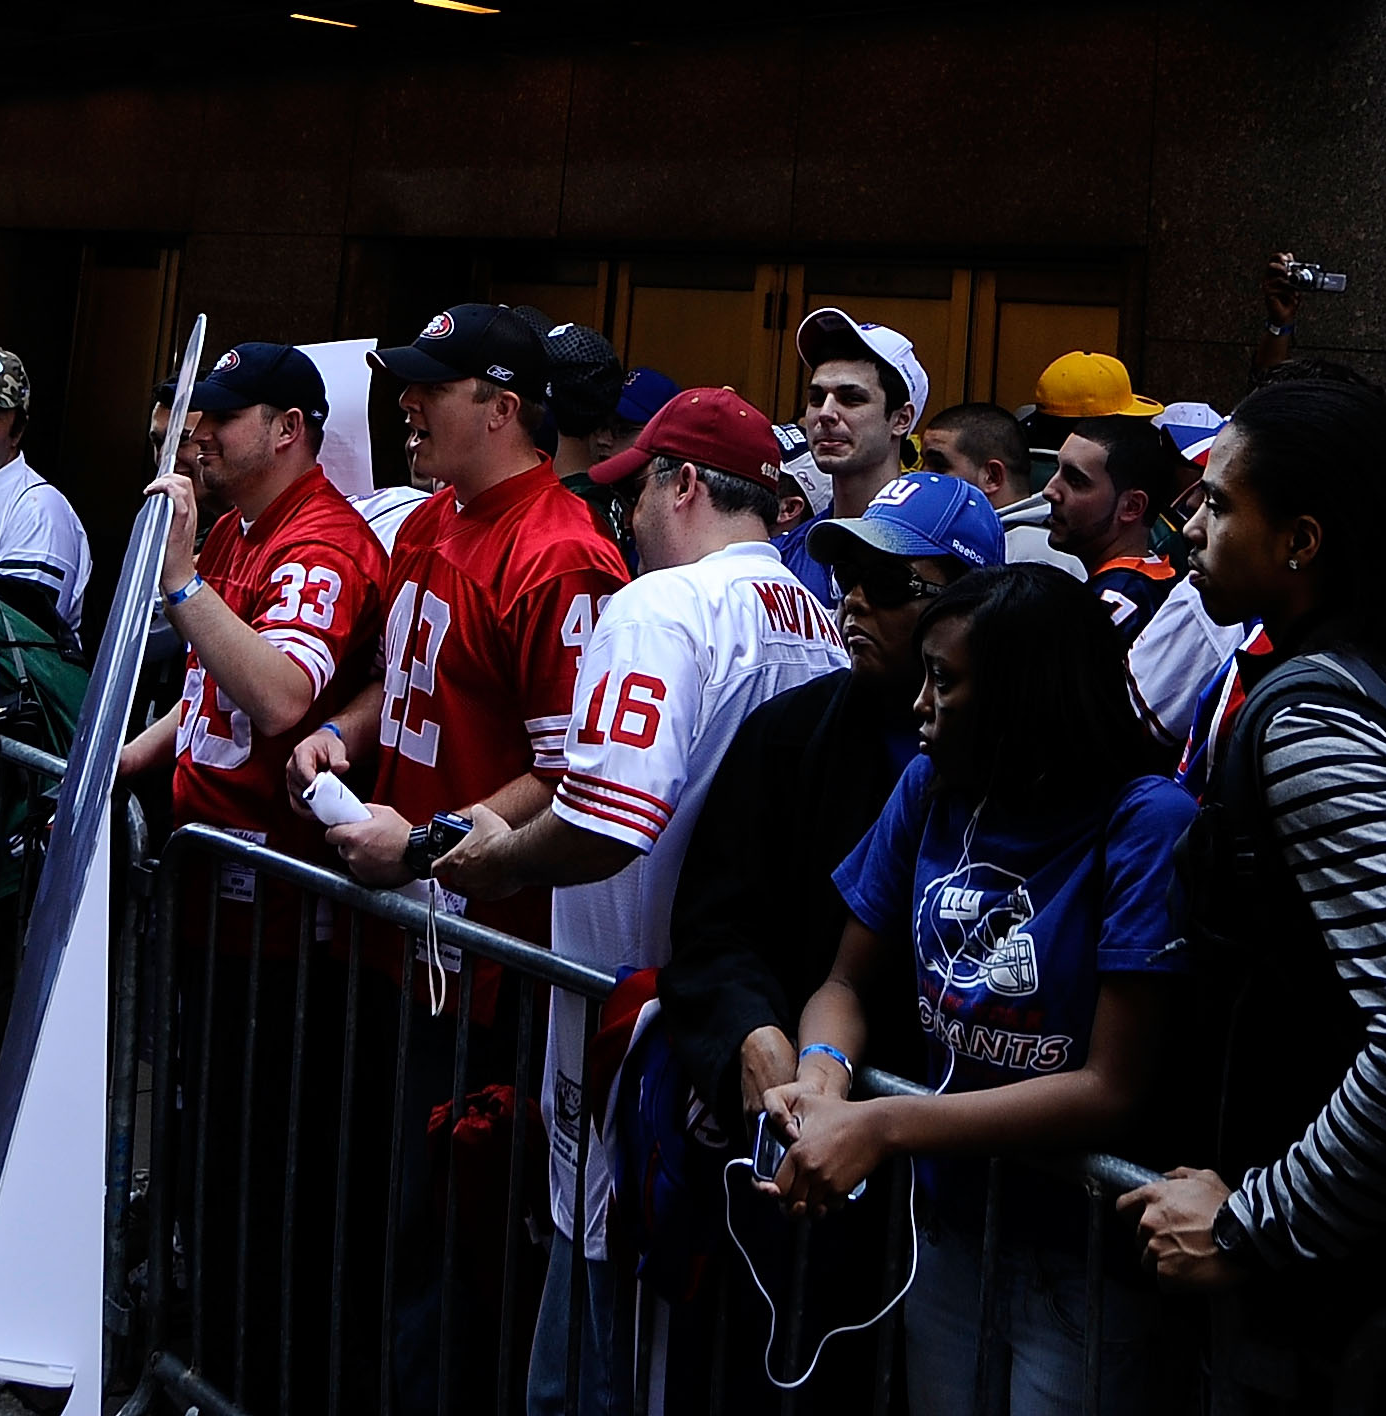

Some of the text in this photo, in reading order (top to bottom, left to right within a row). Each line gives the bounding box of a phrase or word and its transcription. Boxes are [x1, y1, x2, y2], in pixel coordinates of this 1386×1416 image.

[265, 561, 343, 631] 33
[560, 593, 614, 671] 4
[379, 579, 452, 768] 42
[576, 670, 667, 750] 16
[918, 995, 1074, 1072] GIANTS
